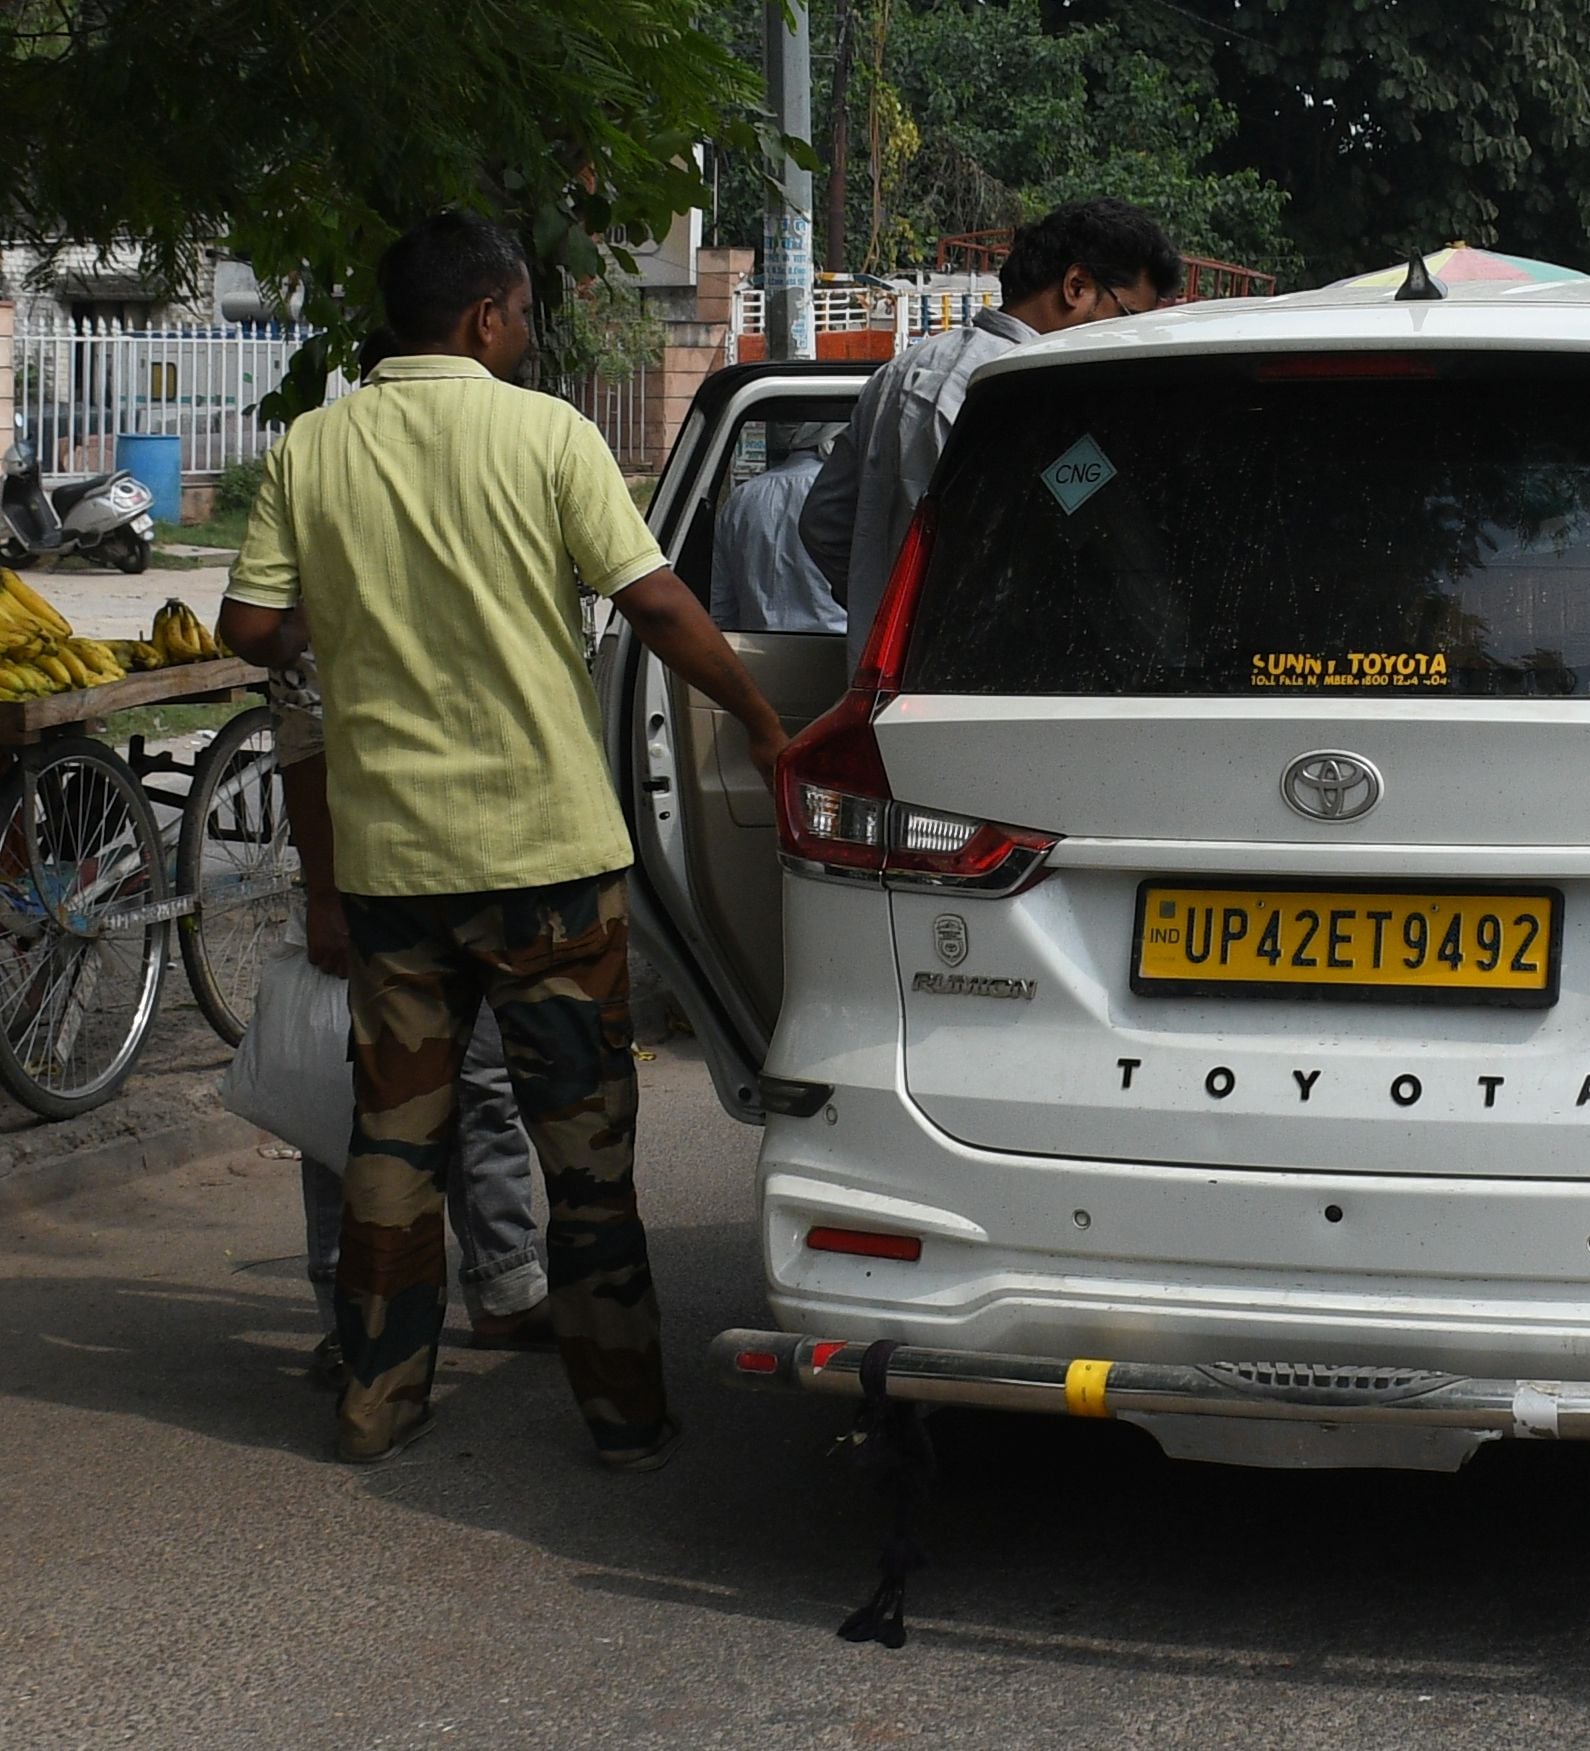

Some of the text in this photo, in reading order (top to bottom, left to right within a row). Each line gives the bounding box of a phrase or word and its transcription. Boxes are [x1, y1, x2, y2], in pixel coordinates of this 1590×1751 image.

[1056, 463, 1101, 484] CNG
[1347, 653, 1446, 674] TOYOTA
[1150, 906, 1541, 973] IND UP42ET9492
[912, 971, 1037, 1000] RUMION
